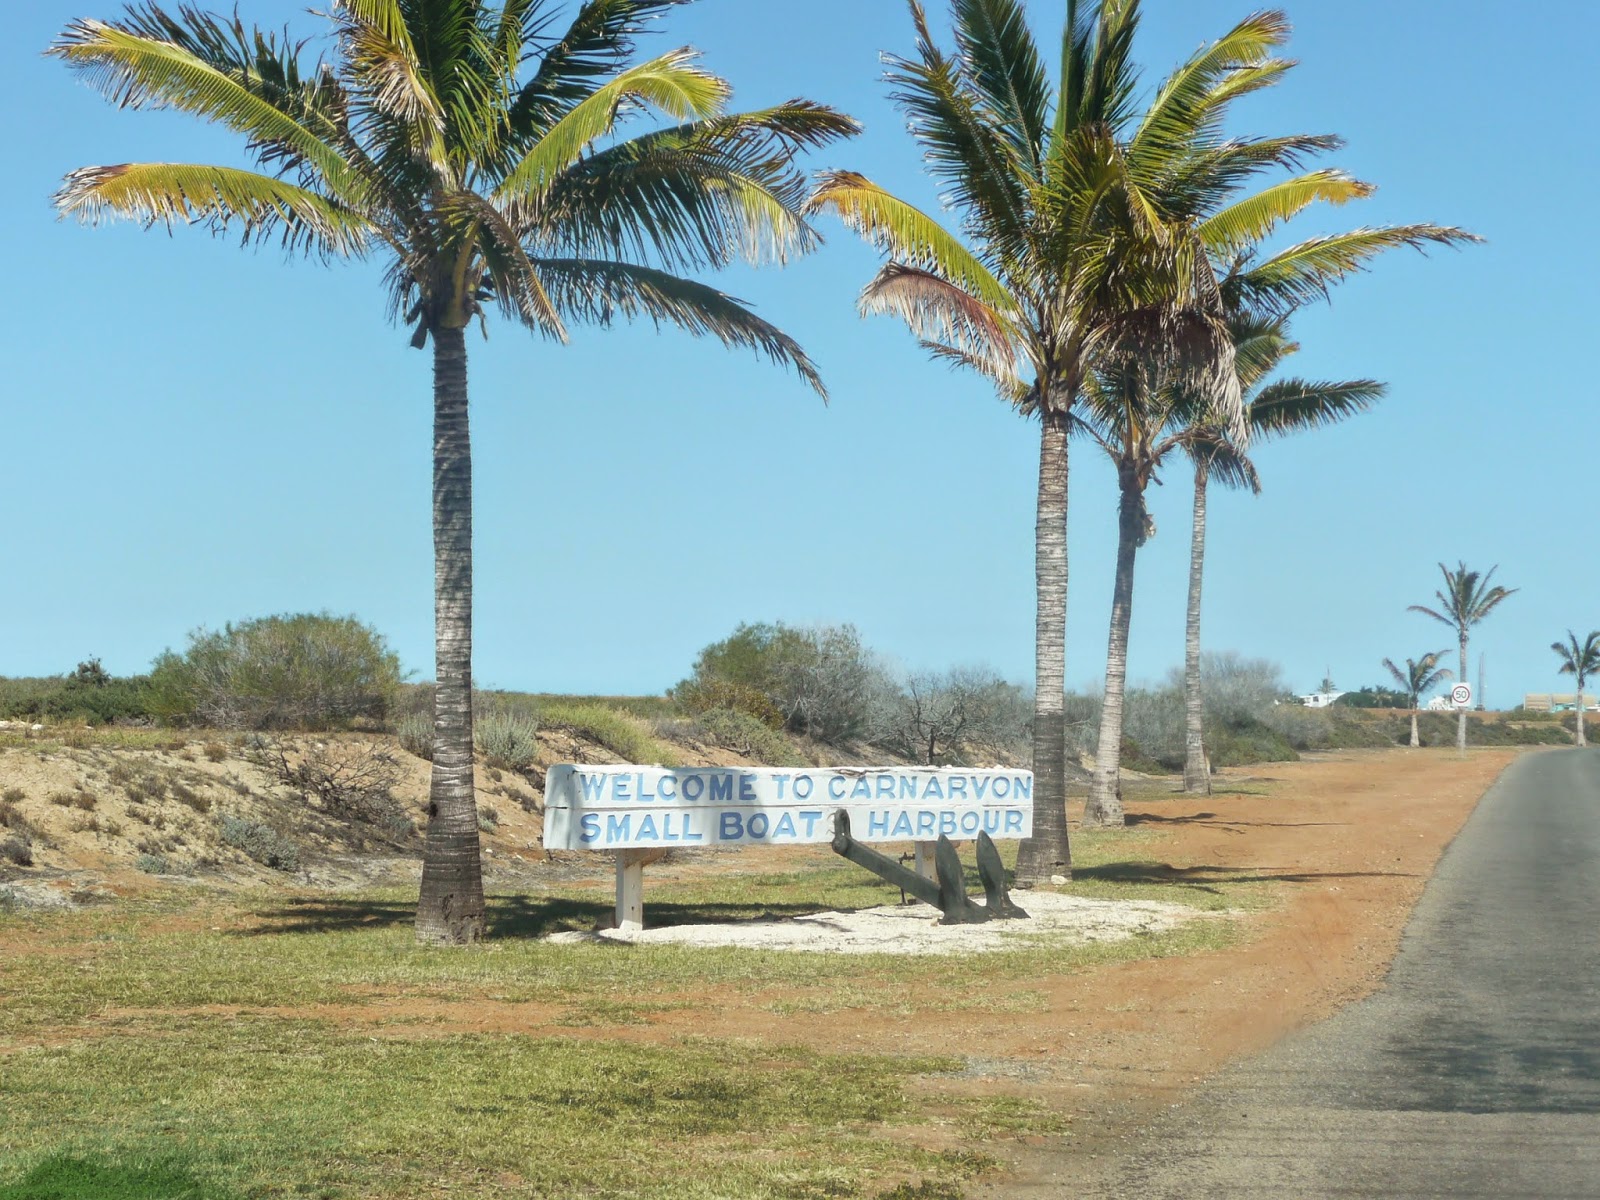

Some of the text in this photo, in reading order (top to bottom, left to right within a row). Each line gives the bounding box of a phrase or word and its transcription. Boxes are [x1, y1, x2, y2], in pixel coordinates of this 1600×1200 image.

[1455, 690, 1467, 699] 50
[579, 773, 1032, 801] WELCOME TO CARNARVON
[579, 810, 1024, 844] SMALL BOAT HARBOUR
